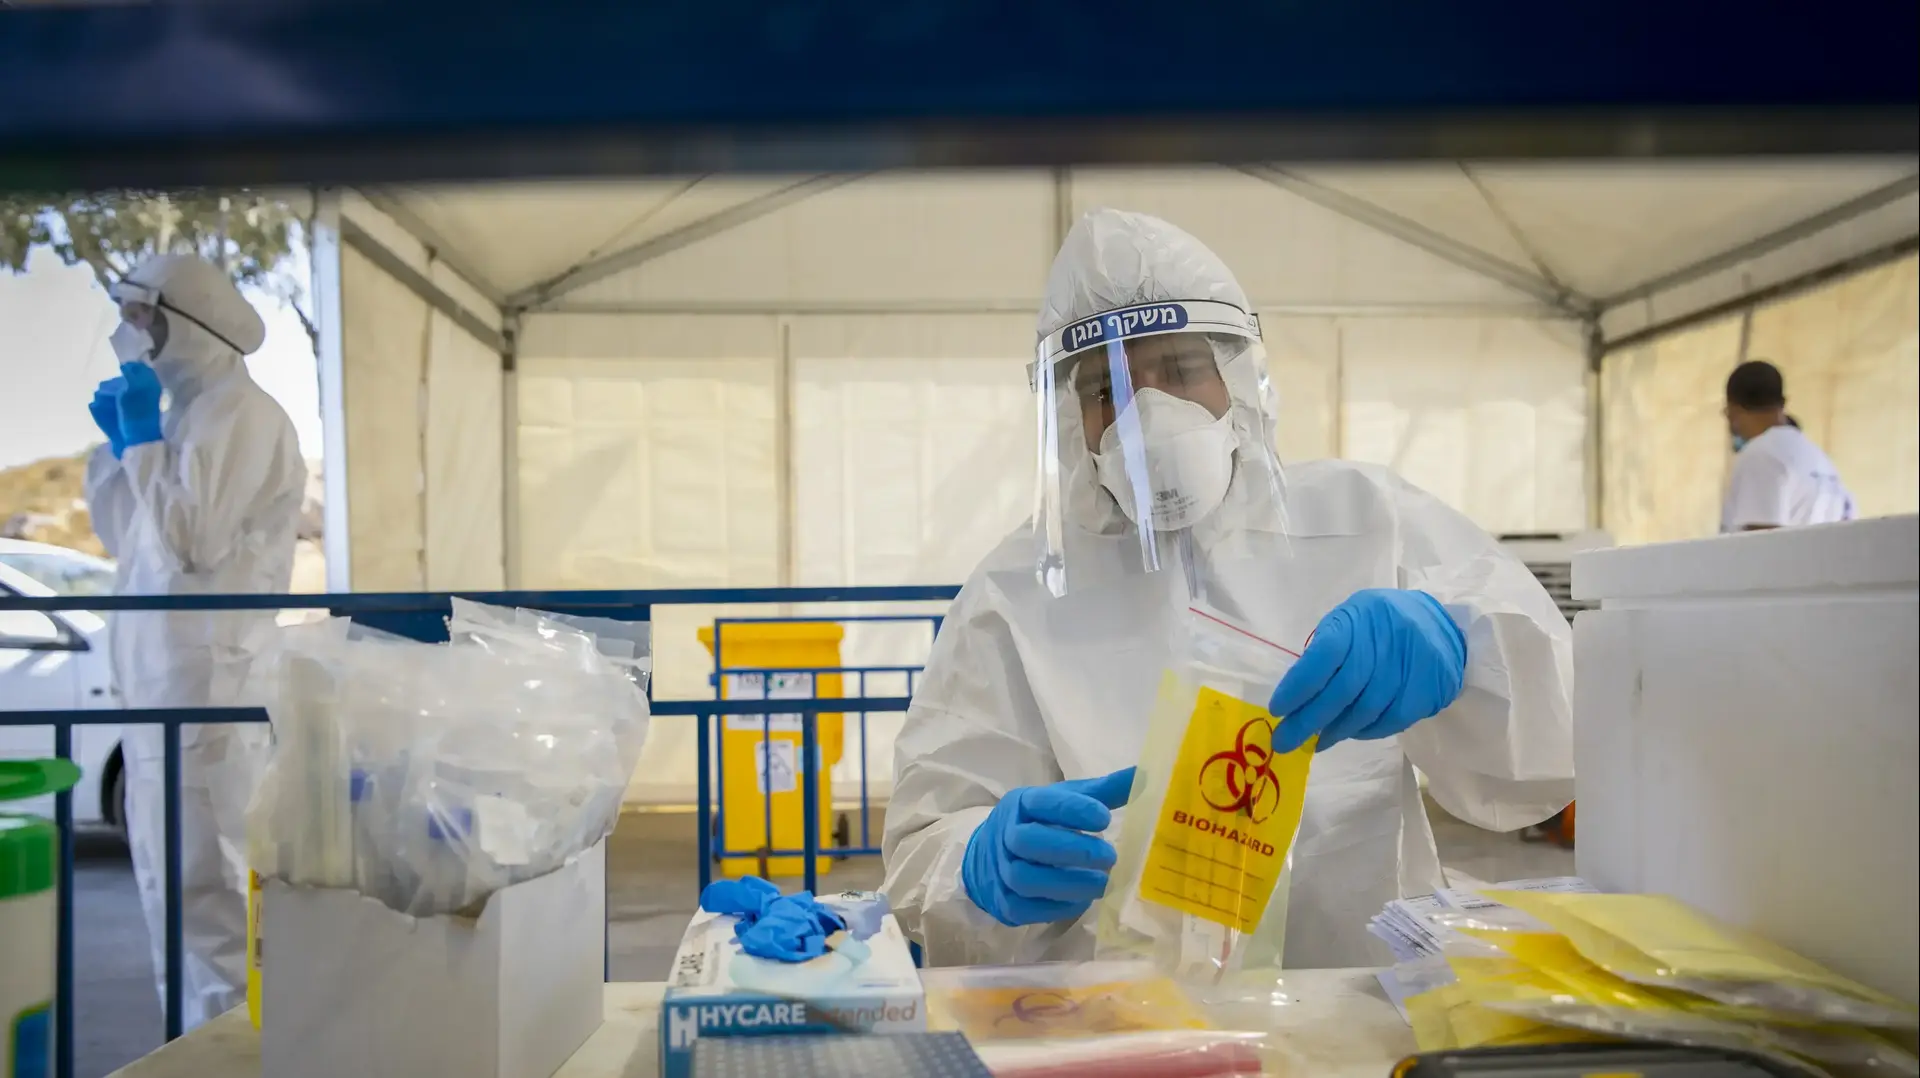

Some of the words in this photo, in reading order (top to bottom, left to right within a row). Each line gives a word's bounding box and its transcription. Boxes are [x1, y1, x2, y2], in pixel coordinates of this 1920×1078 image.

[1071, 319, 1103, 349] מגן
[1107, 307, 1178, 336] משקף
[700, 1003, 806, 1027] HYCARE
